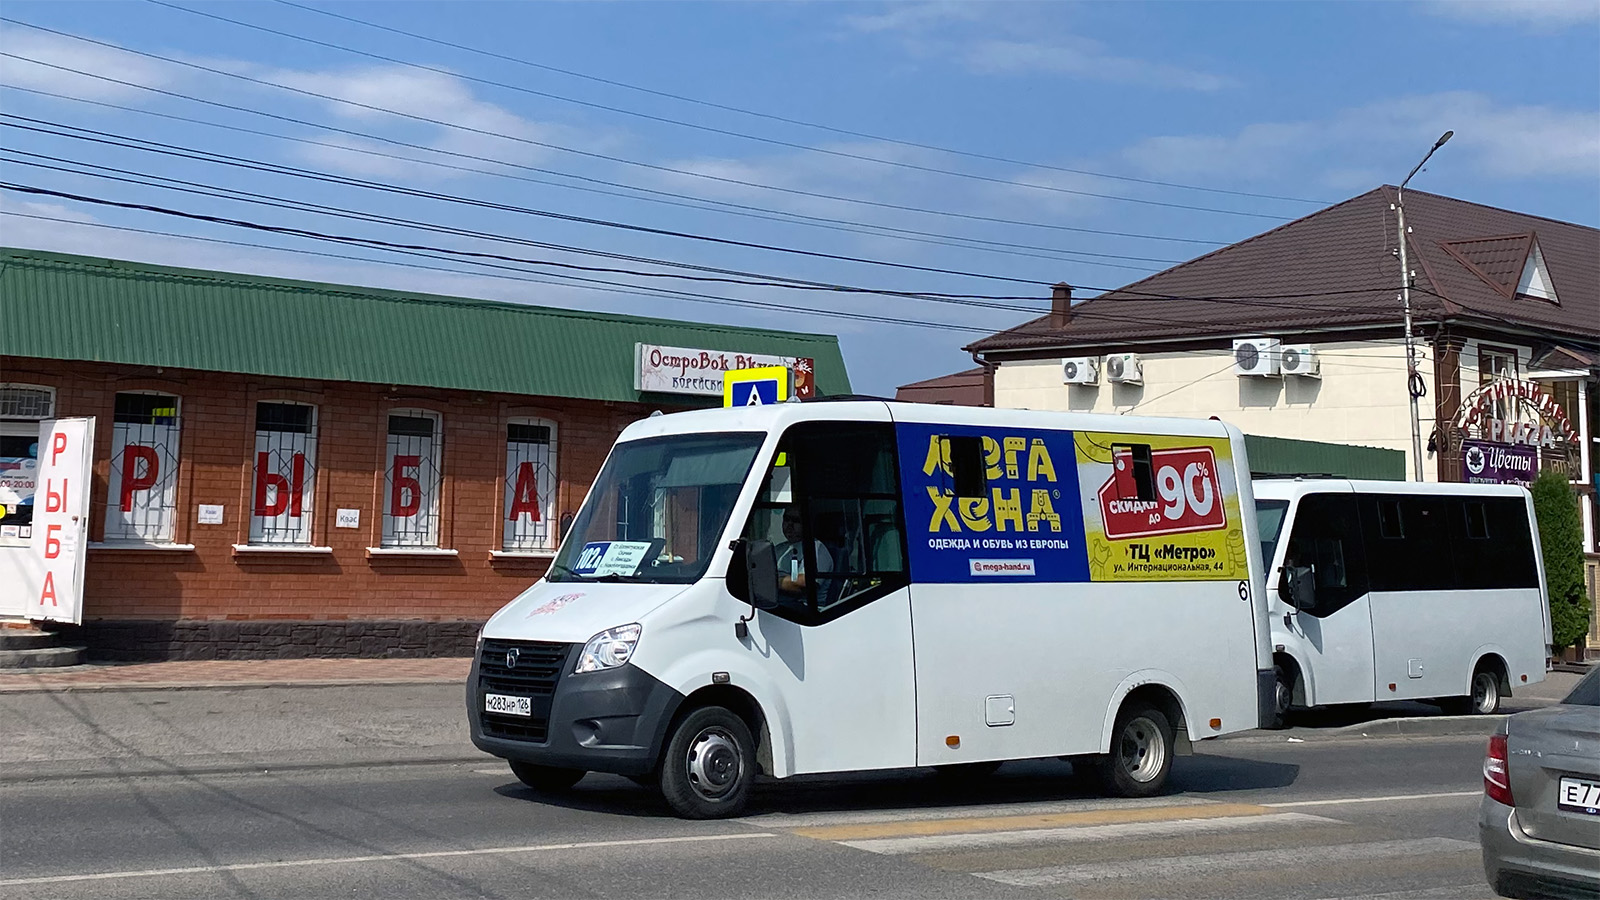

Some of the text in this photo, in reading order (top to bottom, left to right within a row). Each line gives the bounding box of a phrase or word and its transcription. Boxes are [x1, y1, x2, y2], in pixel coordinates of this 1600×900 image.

[671, 376, 725, 392] КОРЕЙСКИ
[1489, 416, 1556, 449] PLAZA
[1487, 446, 1532, 473] Цветы
[1109, 498, 1159, 514] СКИДКИ
[40, 432, 68, 606] РЫБА
[339, 515, 358, 524] Квас
[928, 538, 1069, 550] ОДЕЖДА И ОБУВЬ ИЗ ЕВРОПЫ
[1129, 544, 1216, 563] ТЦ «Метро»
[982, 562, 1031, 573] mega-hand.ru
[1113, 563, 1126, 573] ул.
[1213, 562, 1224, 571] 44
[1237, 580, 1249, 602] 6
